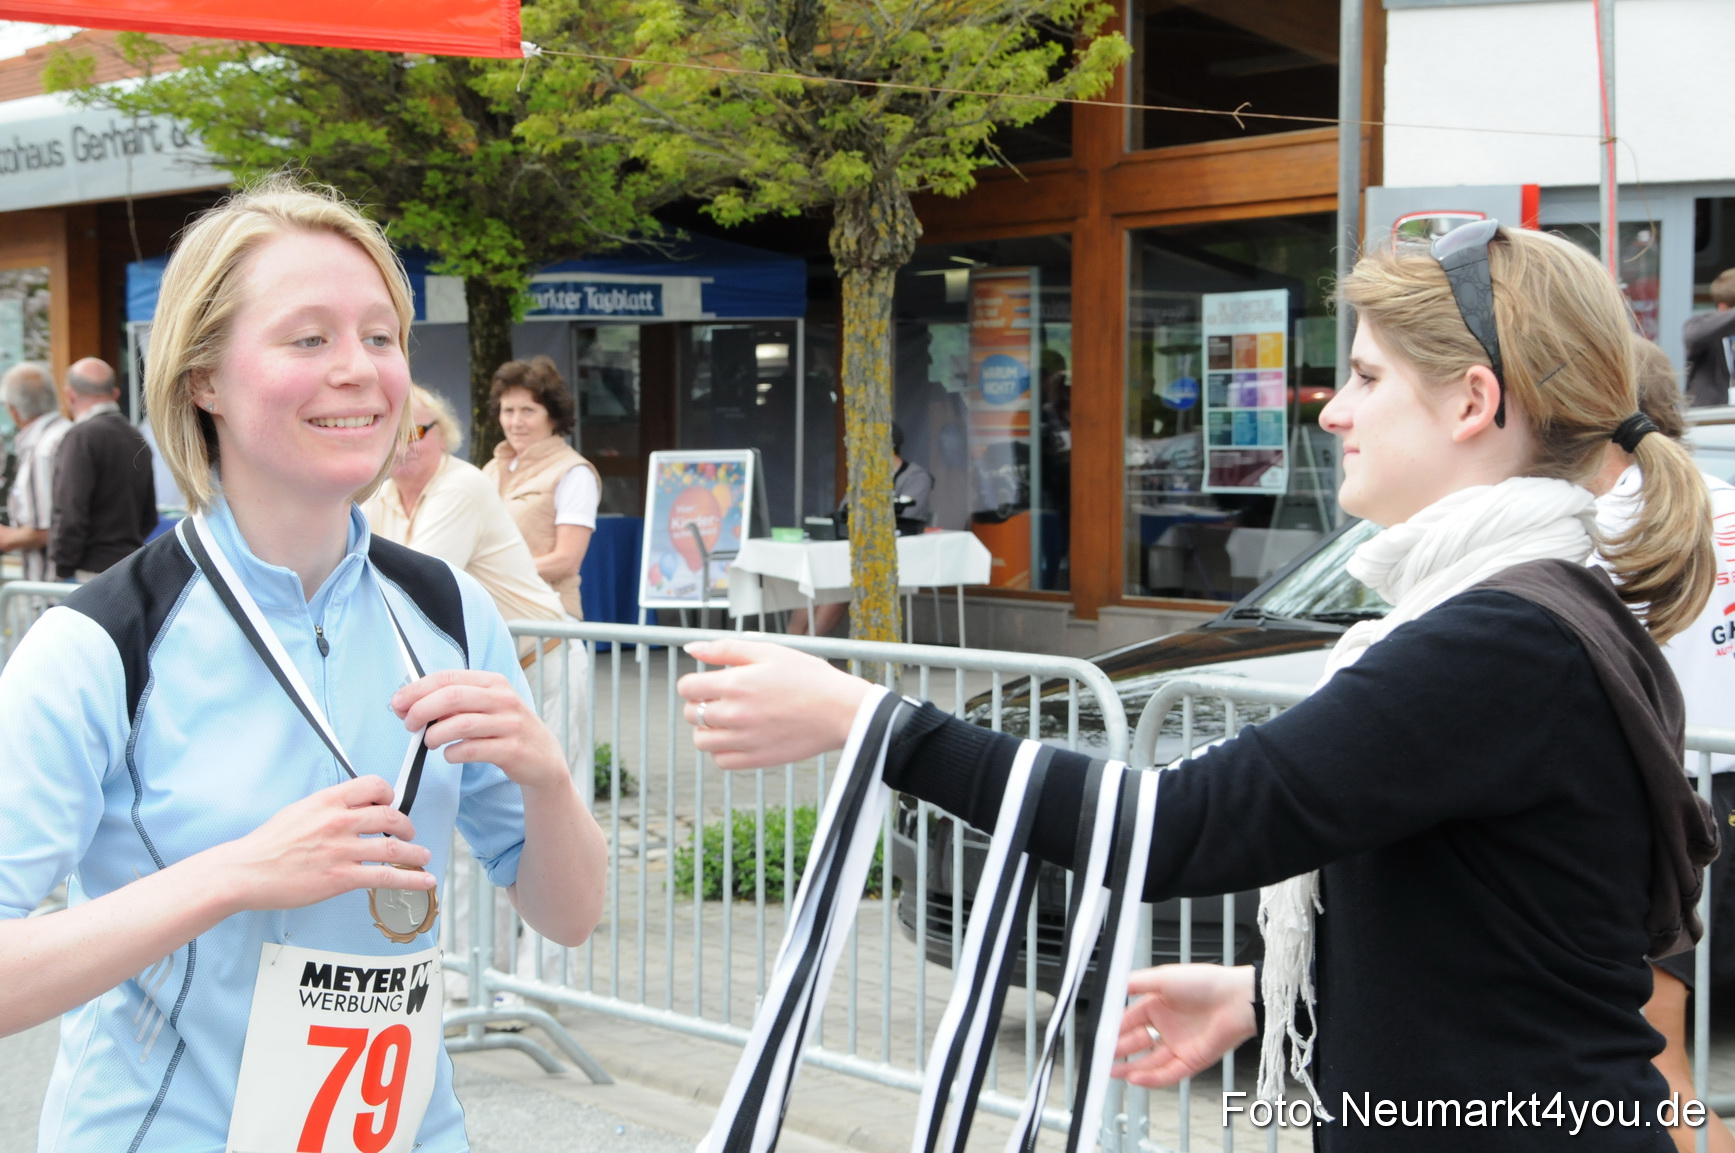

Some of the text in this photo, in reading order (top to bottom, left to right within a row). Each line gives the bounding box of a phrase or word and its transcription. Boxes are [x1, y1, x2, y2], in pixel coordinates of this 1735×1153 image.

[72, 118, 162, 163] Gerhart
[583, 286, 654, 314] Tagblatt
[300, 961, 406, 993] MEYER
[299, 989, 403, 1013] WERBUNG
[297, 1023, 412, 1153] 79
